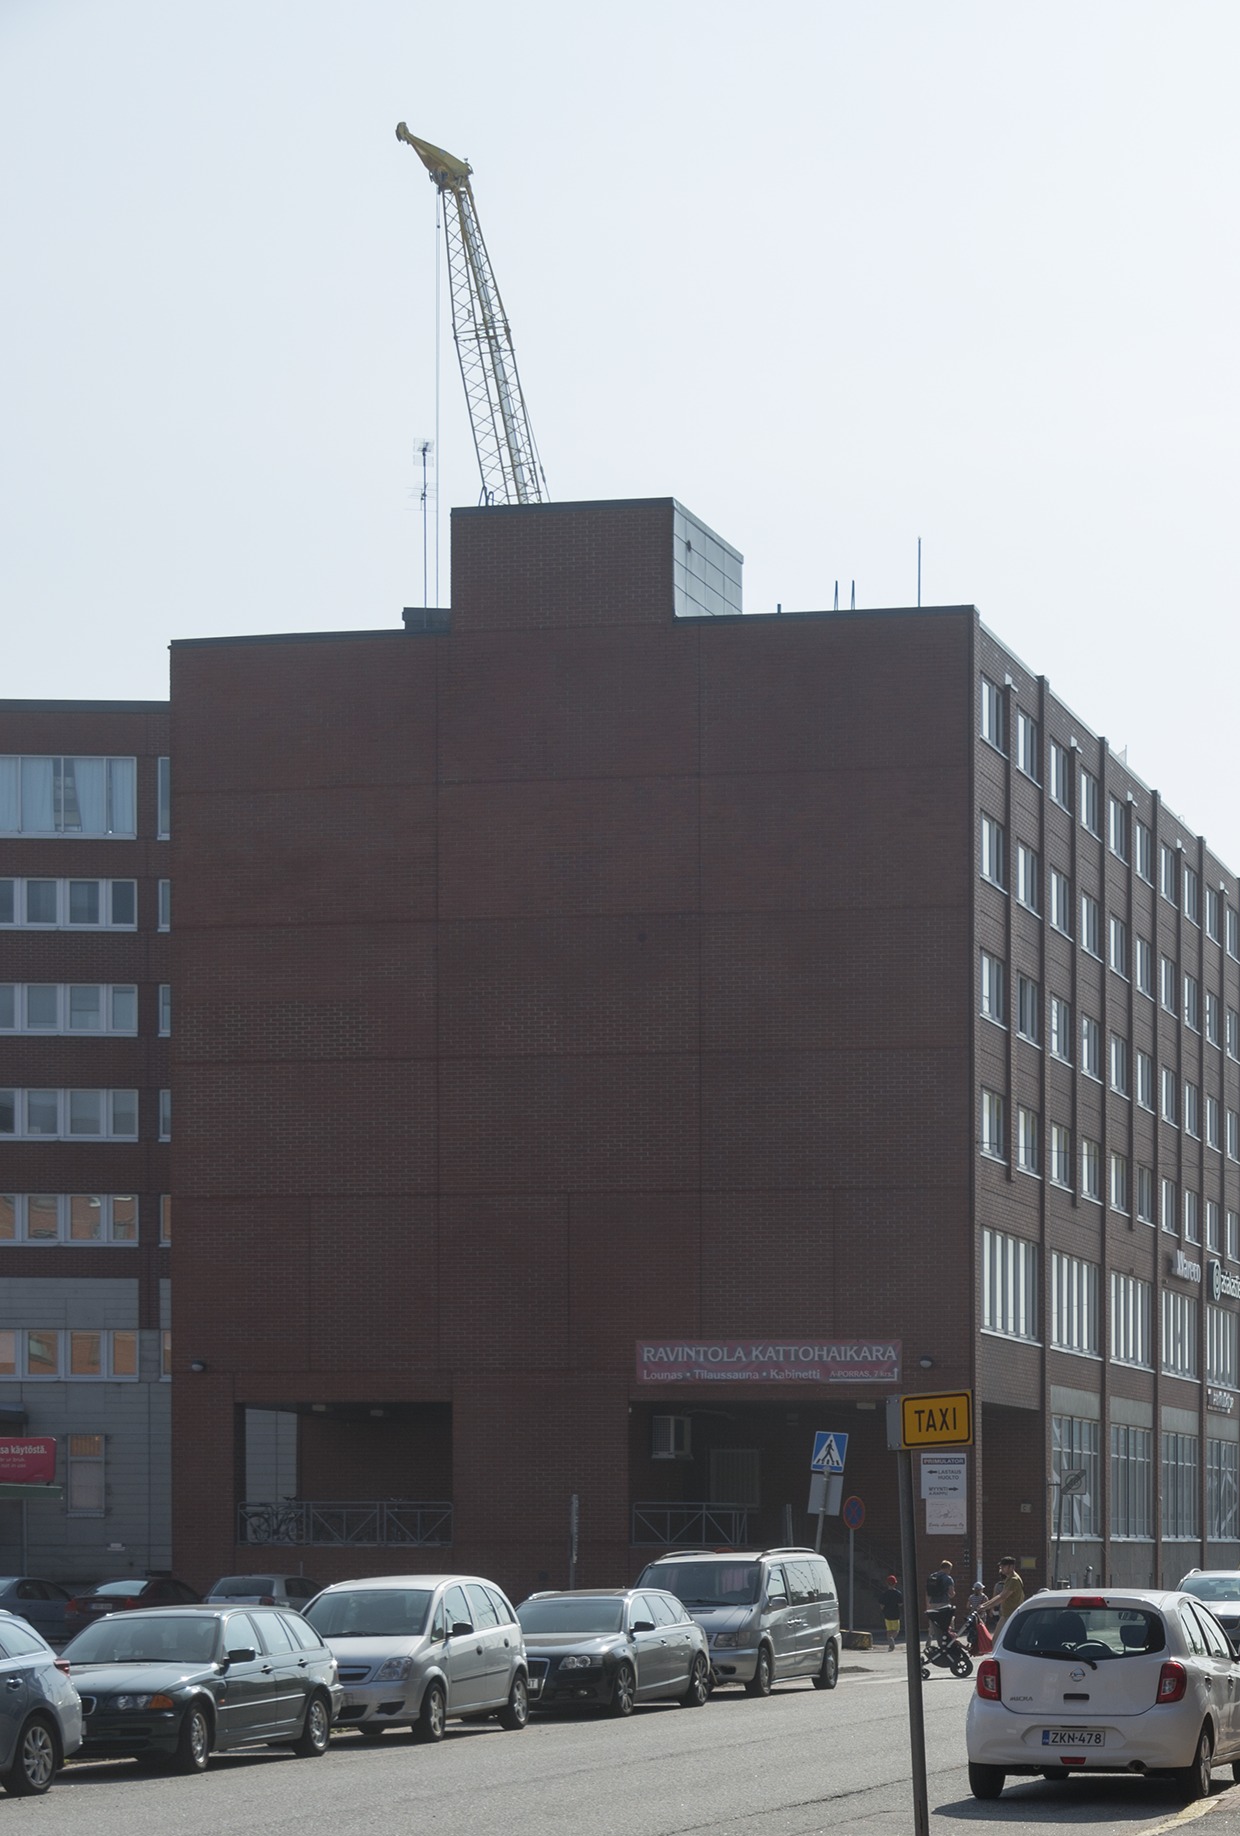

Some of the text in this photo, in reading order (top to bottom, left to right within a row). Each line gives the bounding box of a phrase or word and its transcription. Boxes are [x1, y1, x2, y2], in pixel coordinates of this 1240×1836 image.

[643, 1346, 897, 1361] RAVINTOLA KATTOHAIKARA
[643, 1369, 820, 1380] Lounas Tilaussauna Kabinetti
[914, 1407, 957, 1432] TAXI
[1051, 1732, 1102, 1744] ZKN-478
